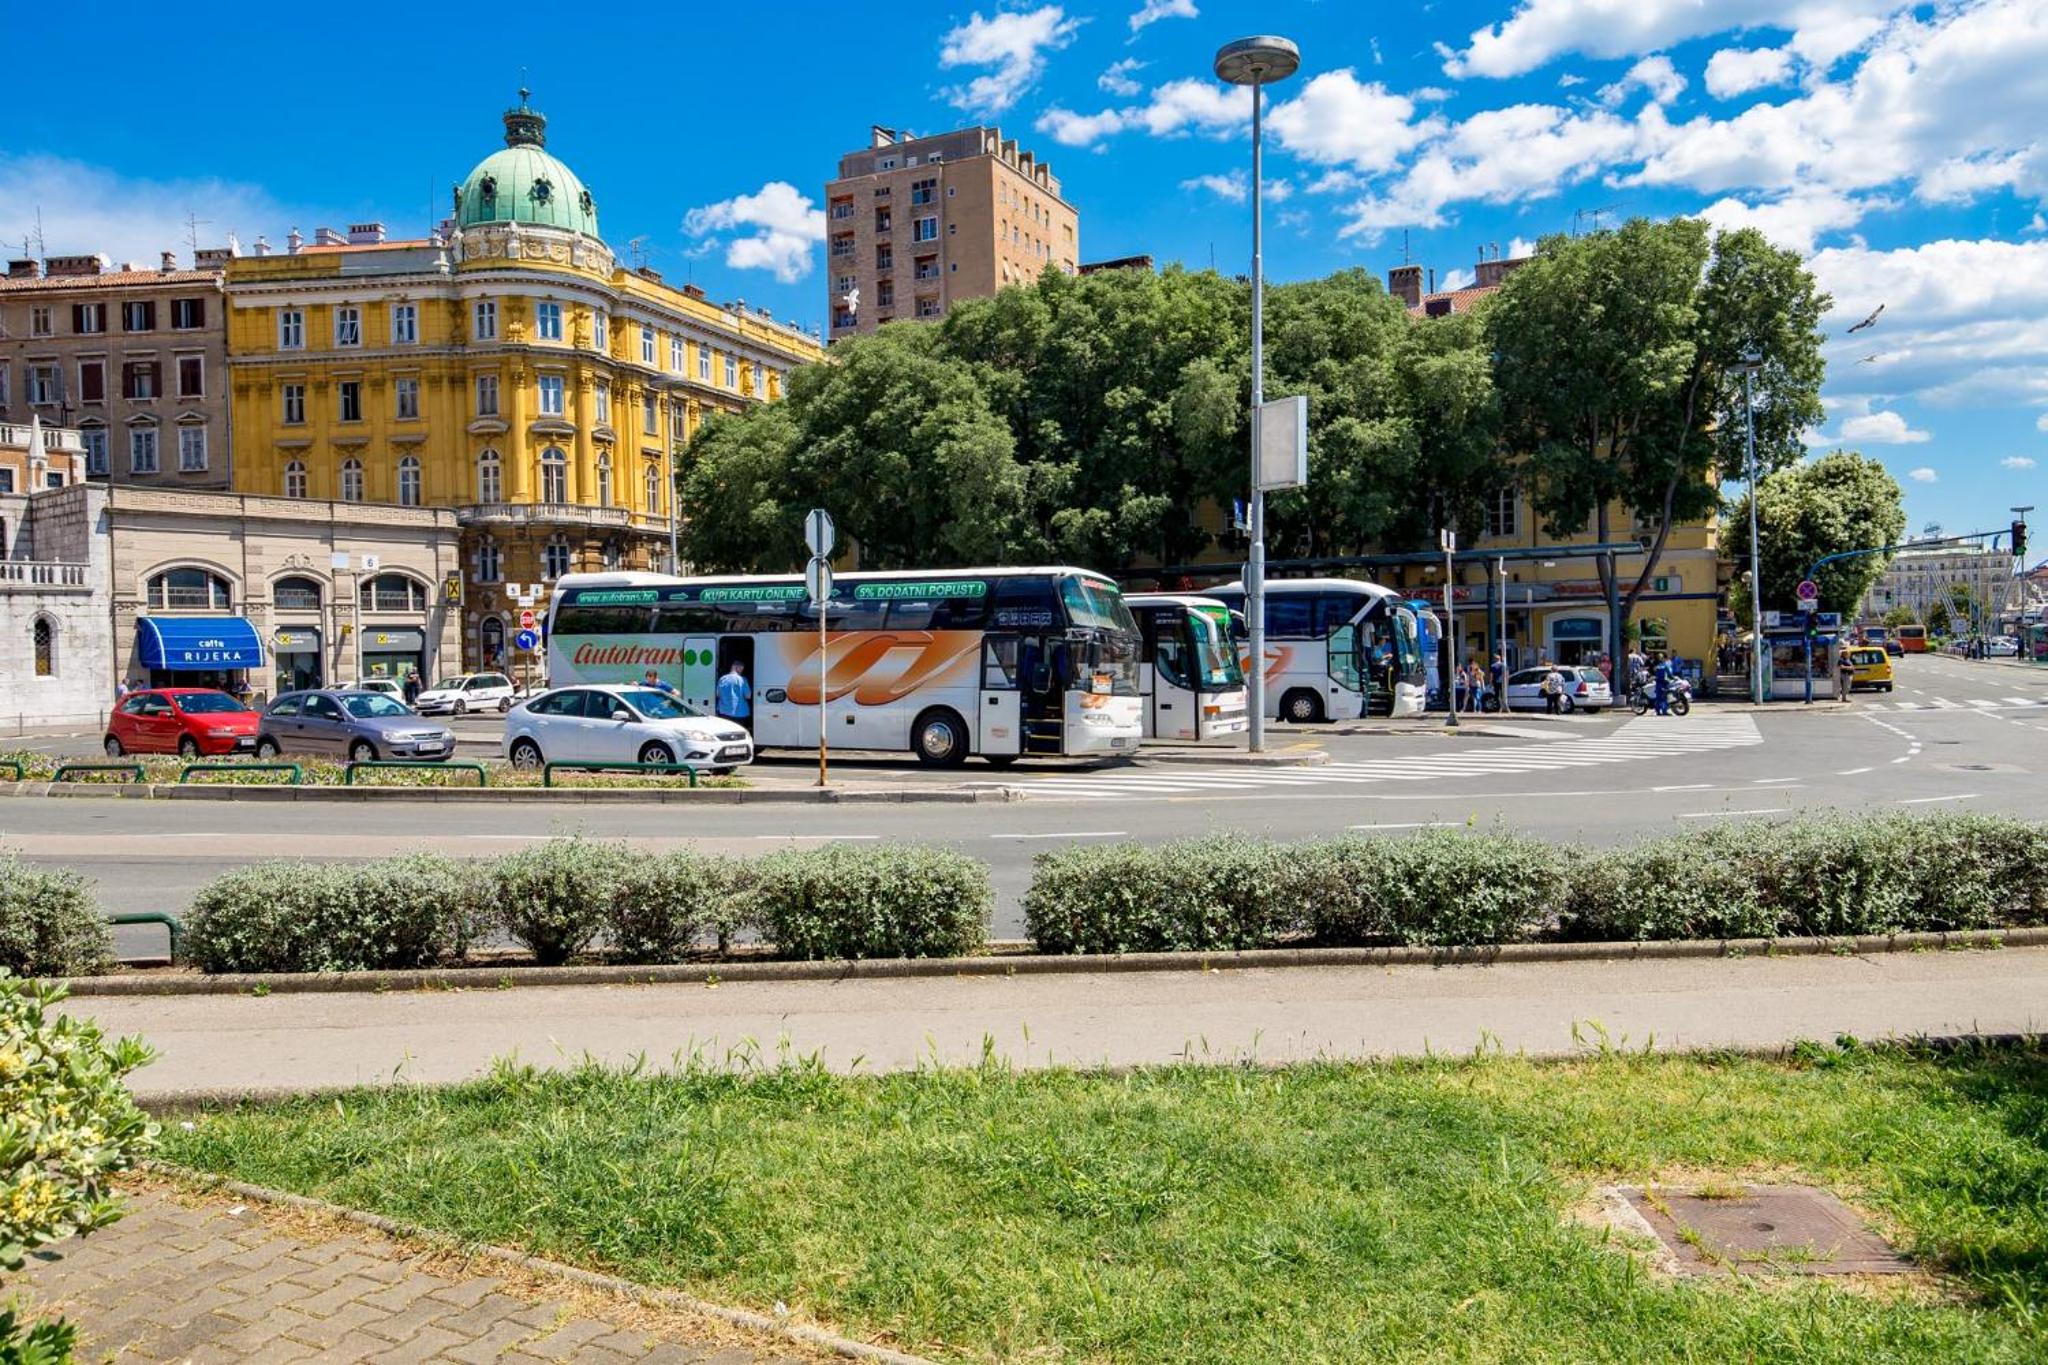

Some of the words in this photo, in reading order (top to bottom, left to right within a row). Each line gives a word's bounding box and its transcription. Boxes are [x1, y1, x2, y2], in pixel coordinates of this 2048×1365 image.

[704, 590, 728, 601] KUPI
[729, 589, 765, 600] KARTU
[765, 588, 803, 599] ONLINE
[859, 587, 875, 598] 5%
[877, 586, 926, 597] DODATNI
[928, 585, 975, 596] POPUST
[184, 651, 241, 662] RIJEKA
